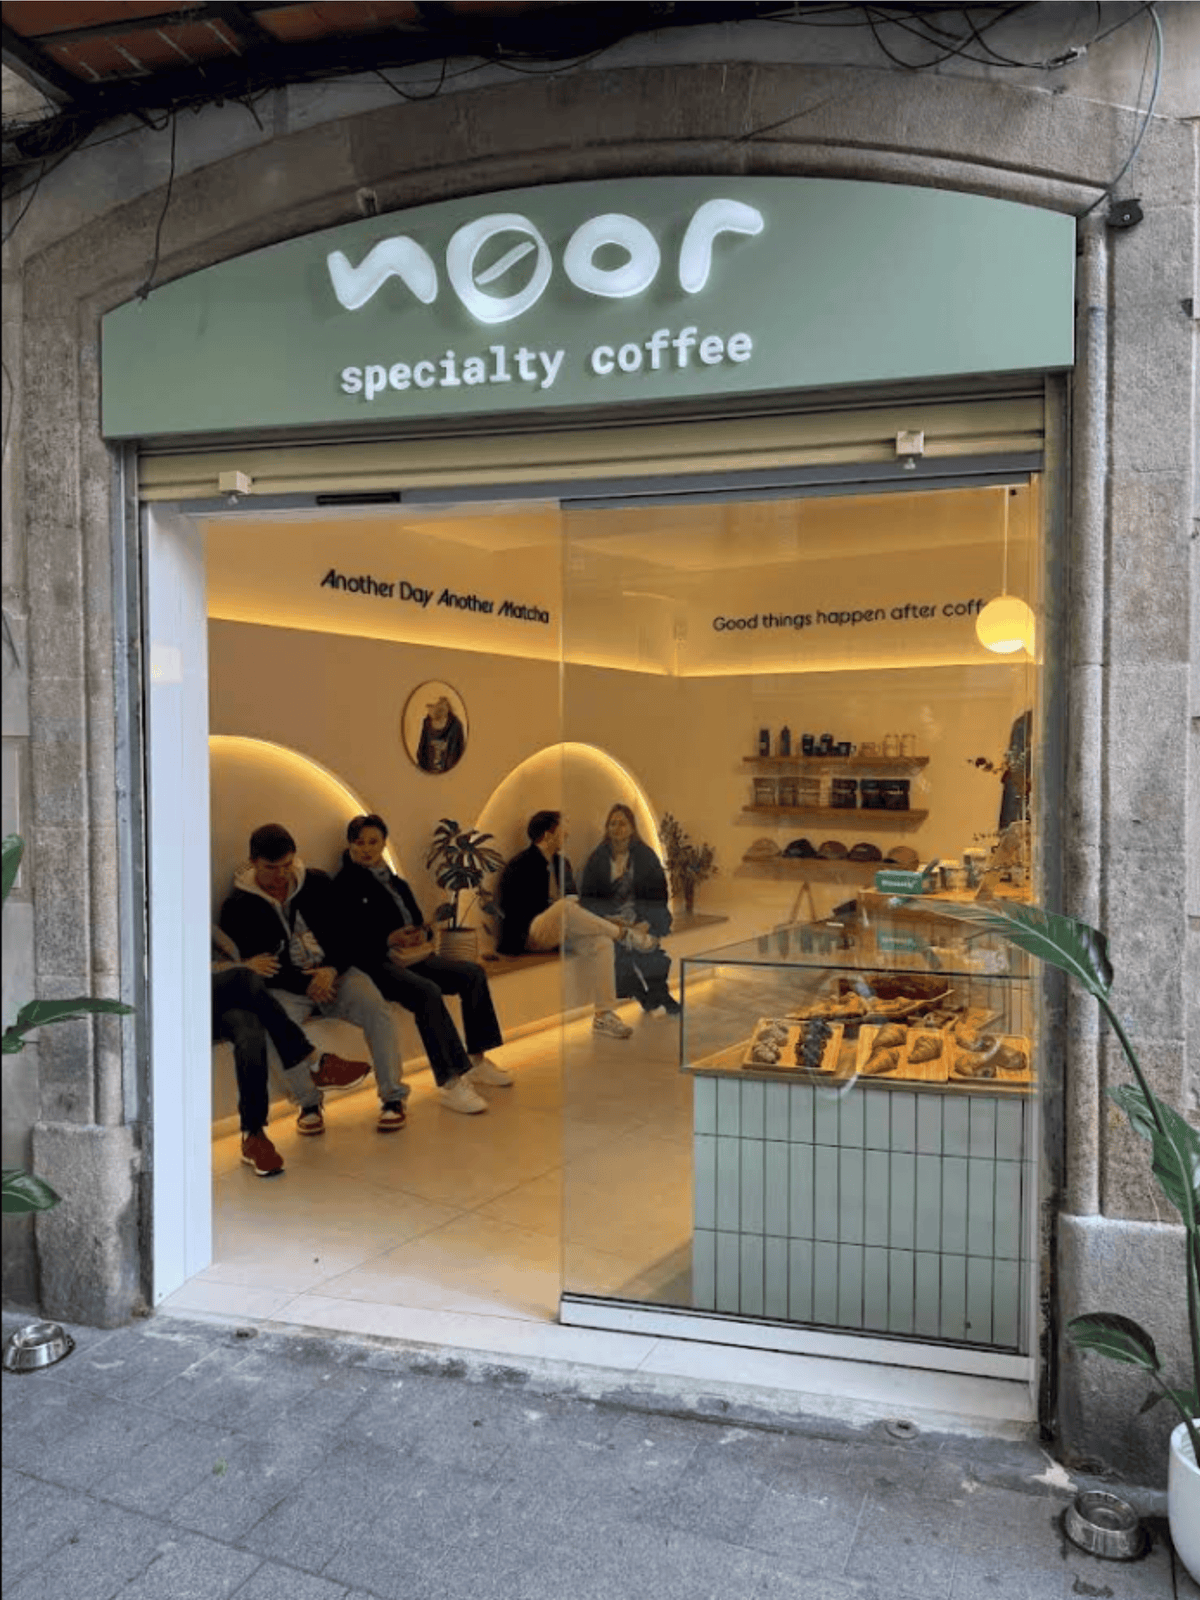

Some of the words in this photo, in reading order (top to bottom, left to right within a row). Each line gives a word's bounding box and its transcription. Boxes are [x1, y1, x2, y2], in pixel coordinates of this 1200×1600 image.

[327, 198, 764, 323] noor
[340, 345, 566, 400] specialty
[591, 326, 753, 375] coffee
[320, 568, 395, 598] Another
[399, 580, 434, 608] Day
[438, 588, 494, 614] Another
[498, 600, 550, 624] Matcha
[713, 614, 758, 632] Good
[762, 612, 812, 630] things
[816, 605, 886, 627] happen
[890, 602, 936, 621] after
[942, 598, 988, 617] coff
